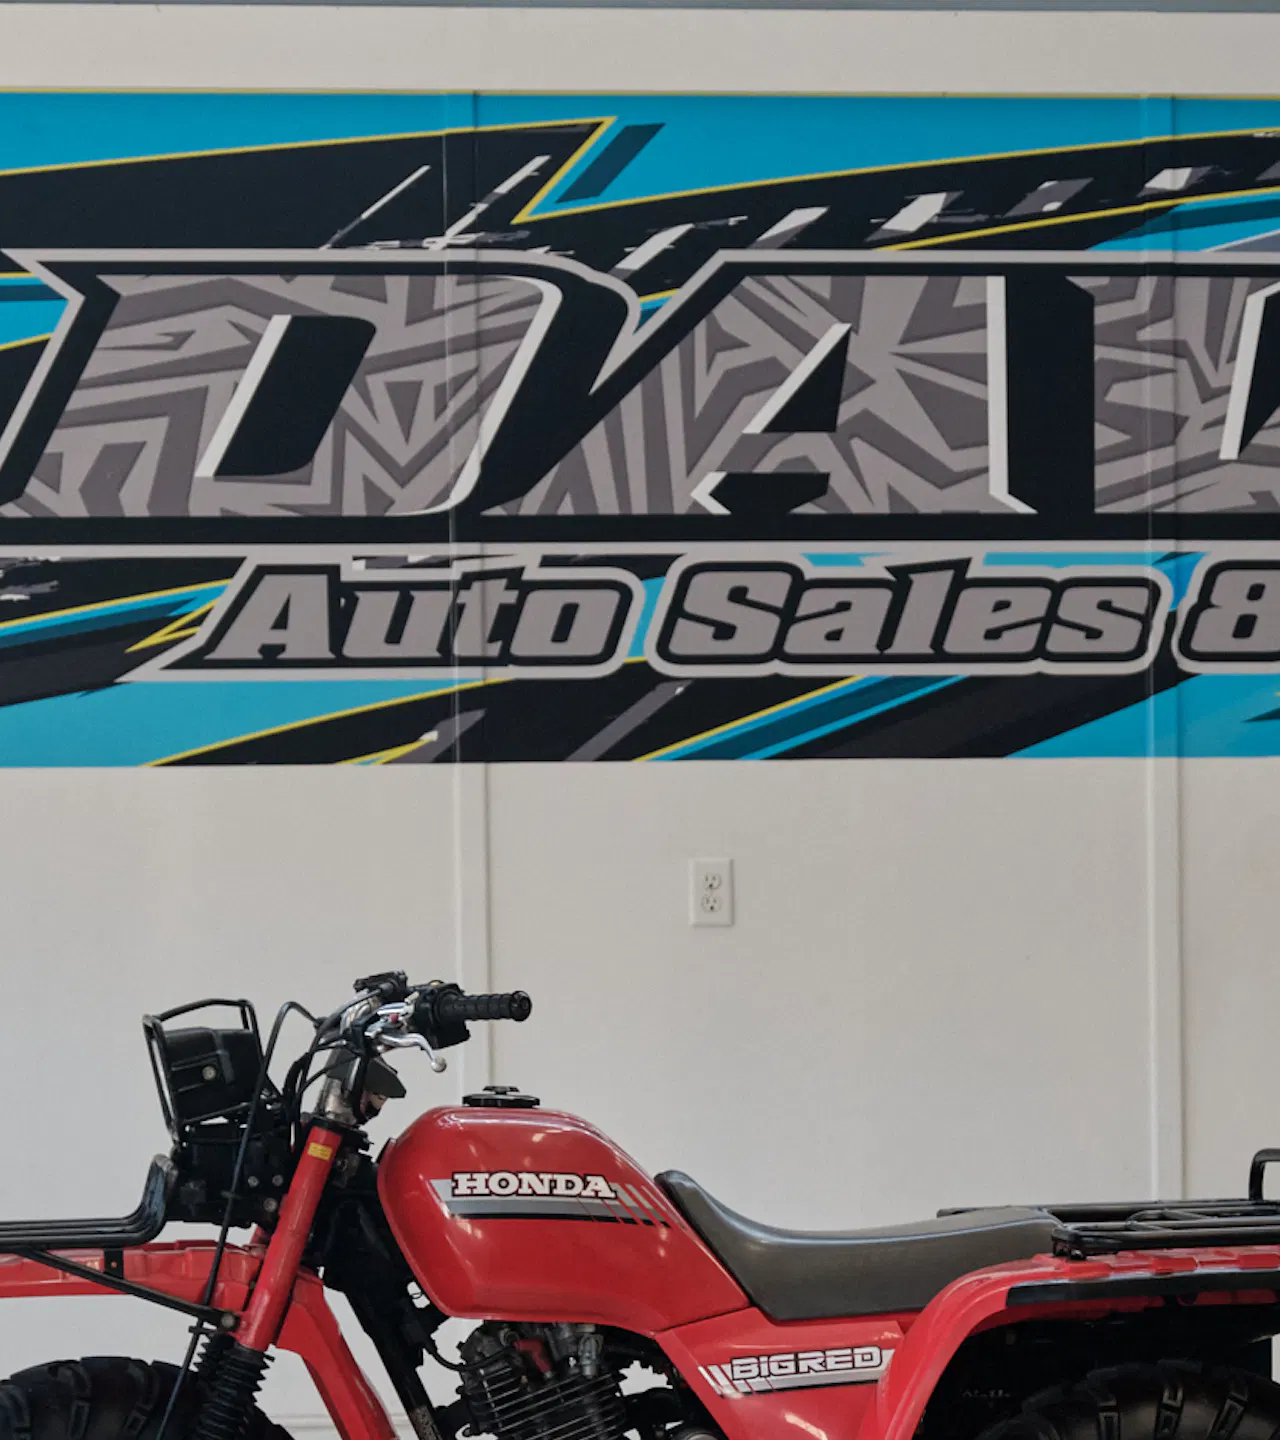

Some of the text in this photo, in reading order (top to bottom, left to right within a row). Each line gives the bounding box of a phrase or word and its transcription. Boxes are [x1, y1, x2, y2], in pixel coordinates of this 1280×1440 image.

[210, 568, 628, 661] Auto
[671, 564, 1154, 661] Sales
[452, 1171, 618, 1199] HONDA
